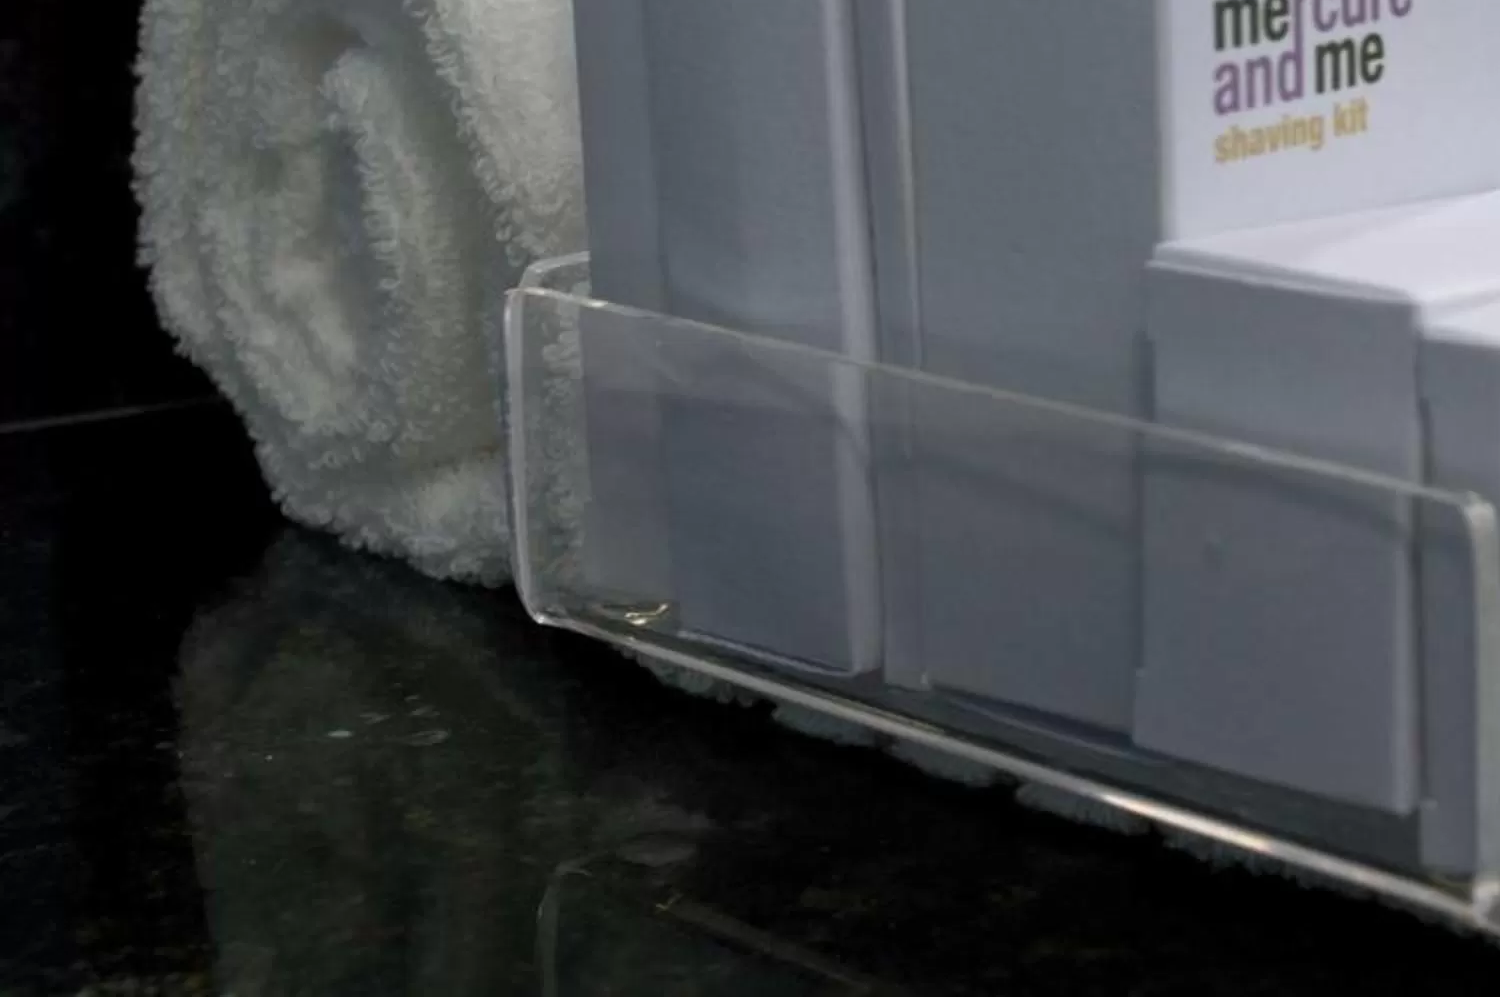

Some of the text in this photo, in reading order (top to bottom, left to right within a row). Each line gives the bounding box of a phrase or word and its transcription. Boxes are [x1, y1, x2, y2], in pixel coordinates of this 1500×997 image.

[1213, 32, 1385, 115] and me
[1214, 96, 1368, 163] shaving kit
